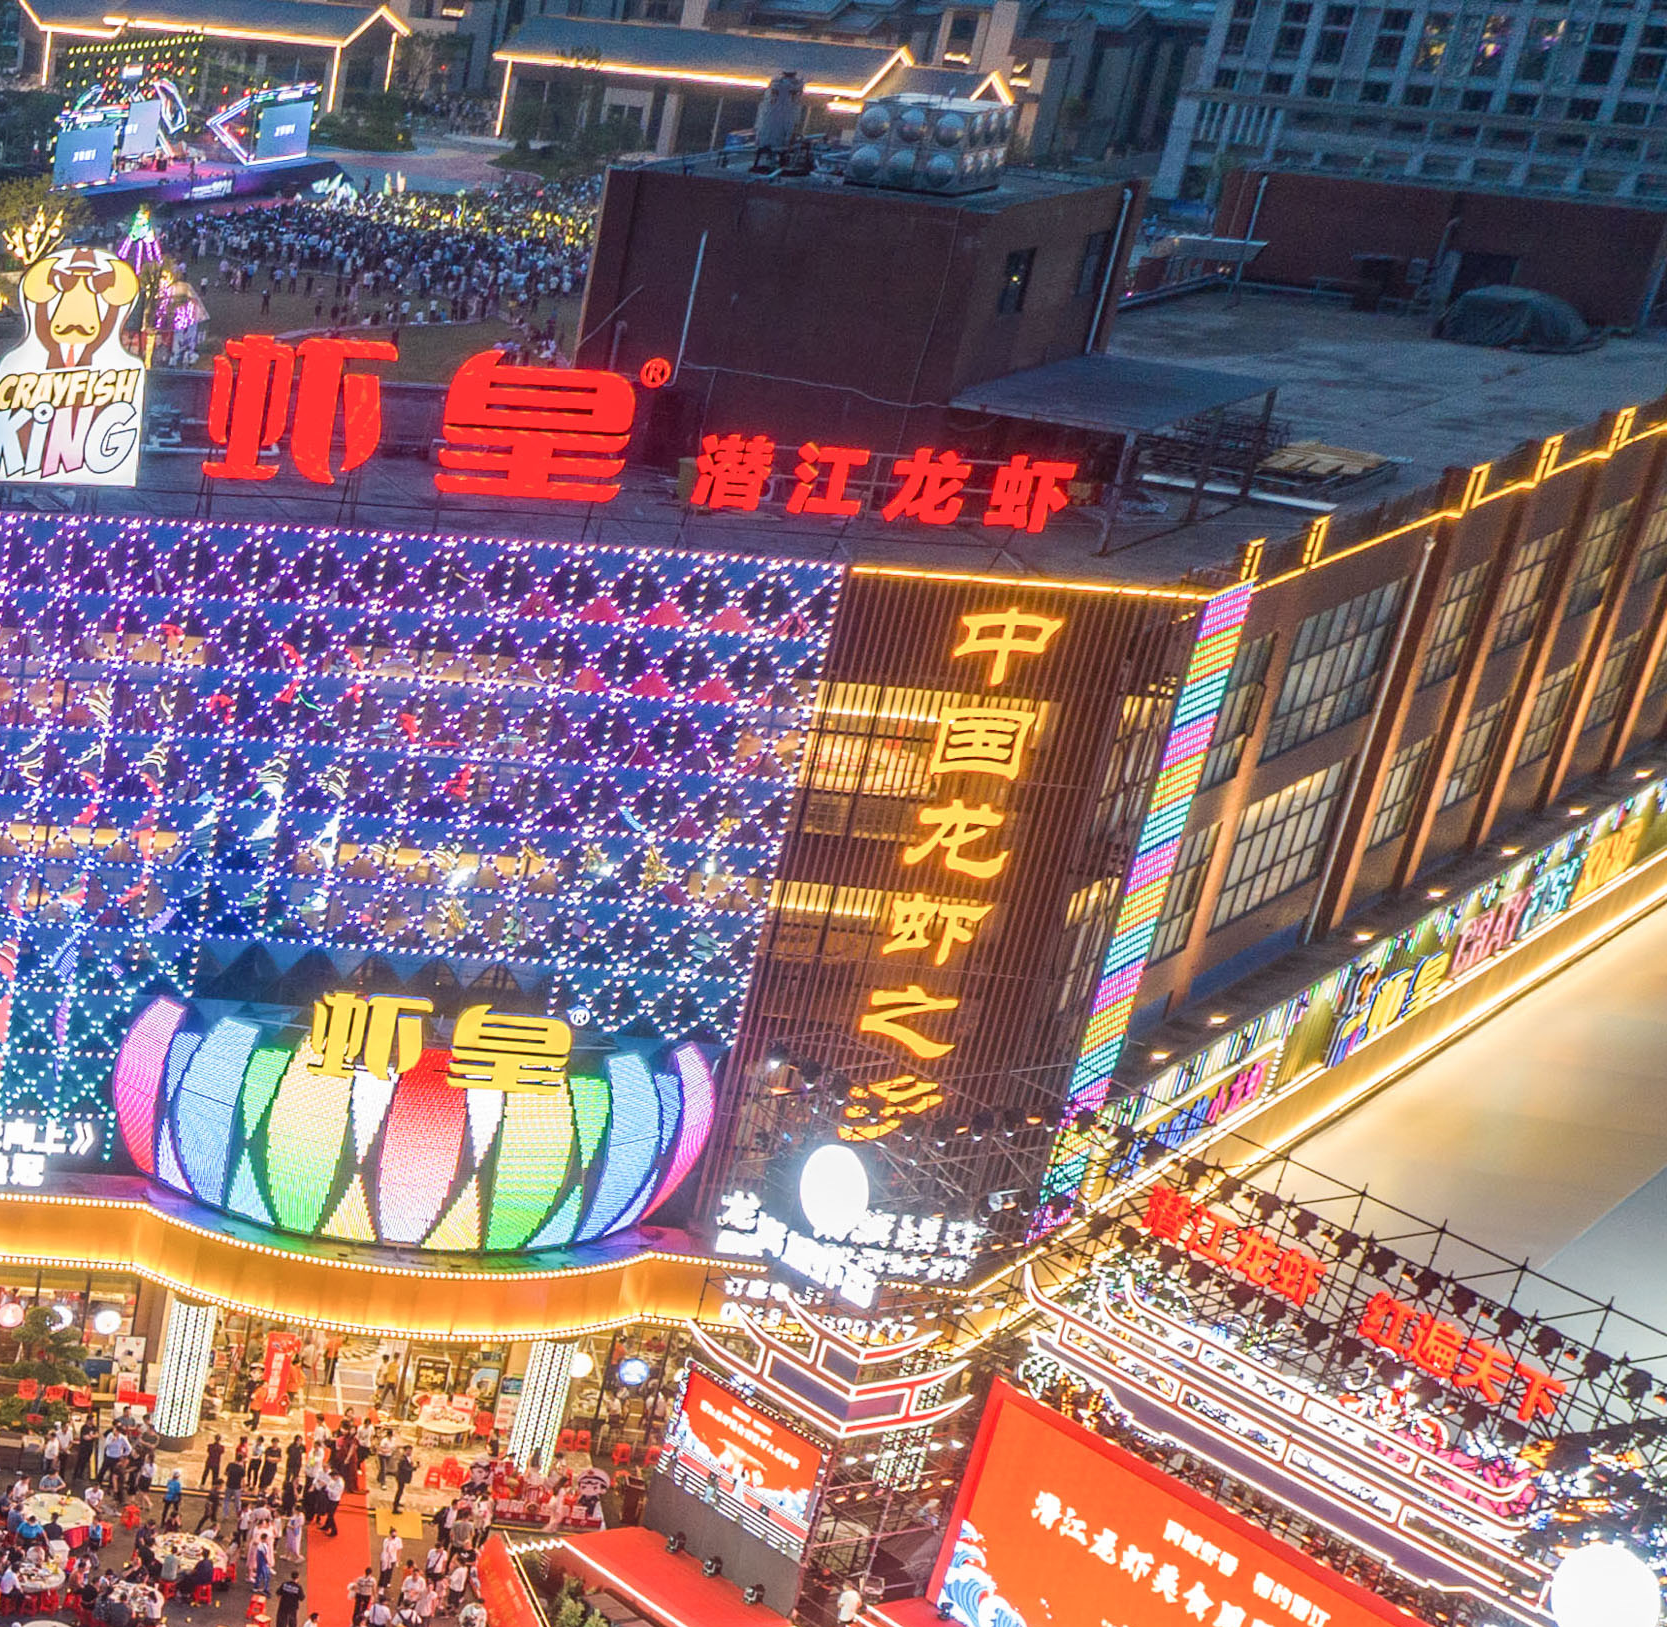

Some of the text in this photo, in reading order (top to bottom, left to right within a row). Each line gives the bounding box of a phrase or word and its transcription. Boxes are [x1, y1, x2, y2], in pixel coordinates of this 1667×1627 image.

[202, 334, 1079, 533] 虾皇 潜江龙虾
[308, 991, 573, 1094] 虾皇
[1368, 950, 1450, 1040] 虾皇
[1143, 1185, 1567, 1421] 潜江龙虾 红遍天下
